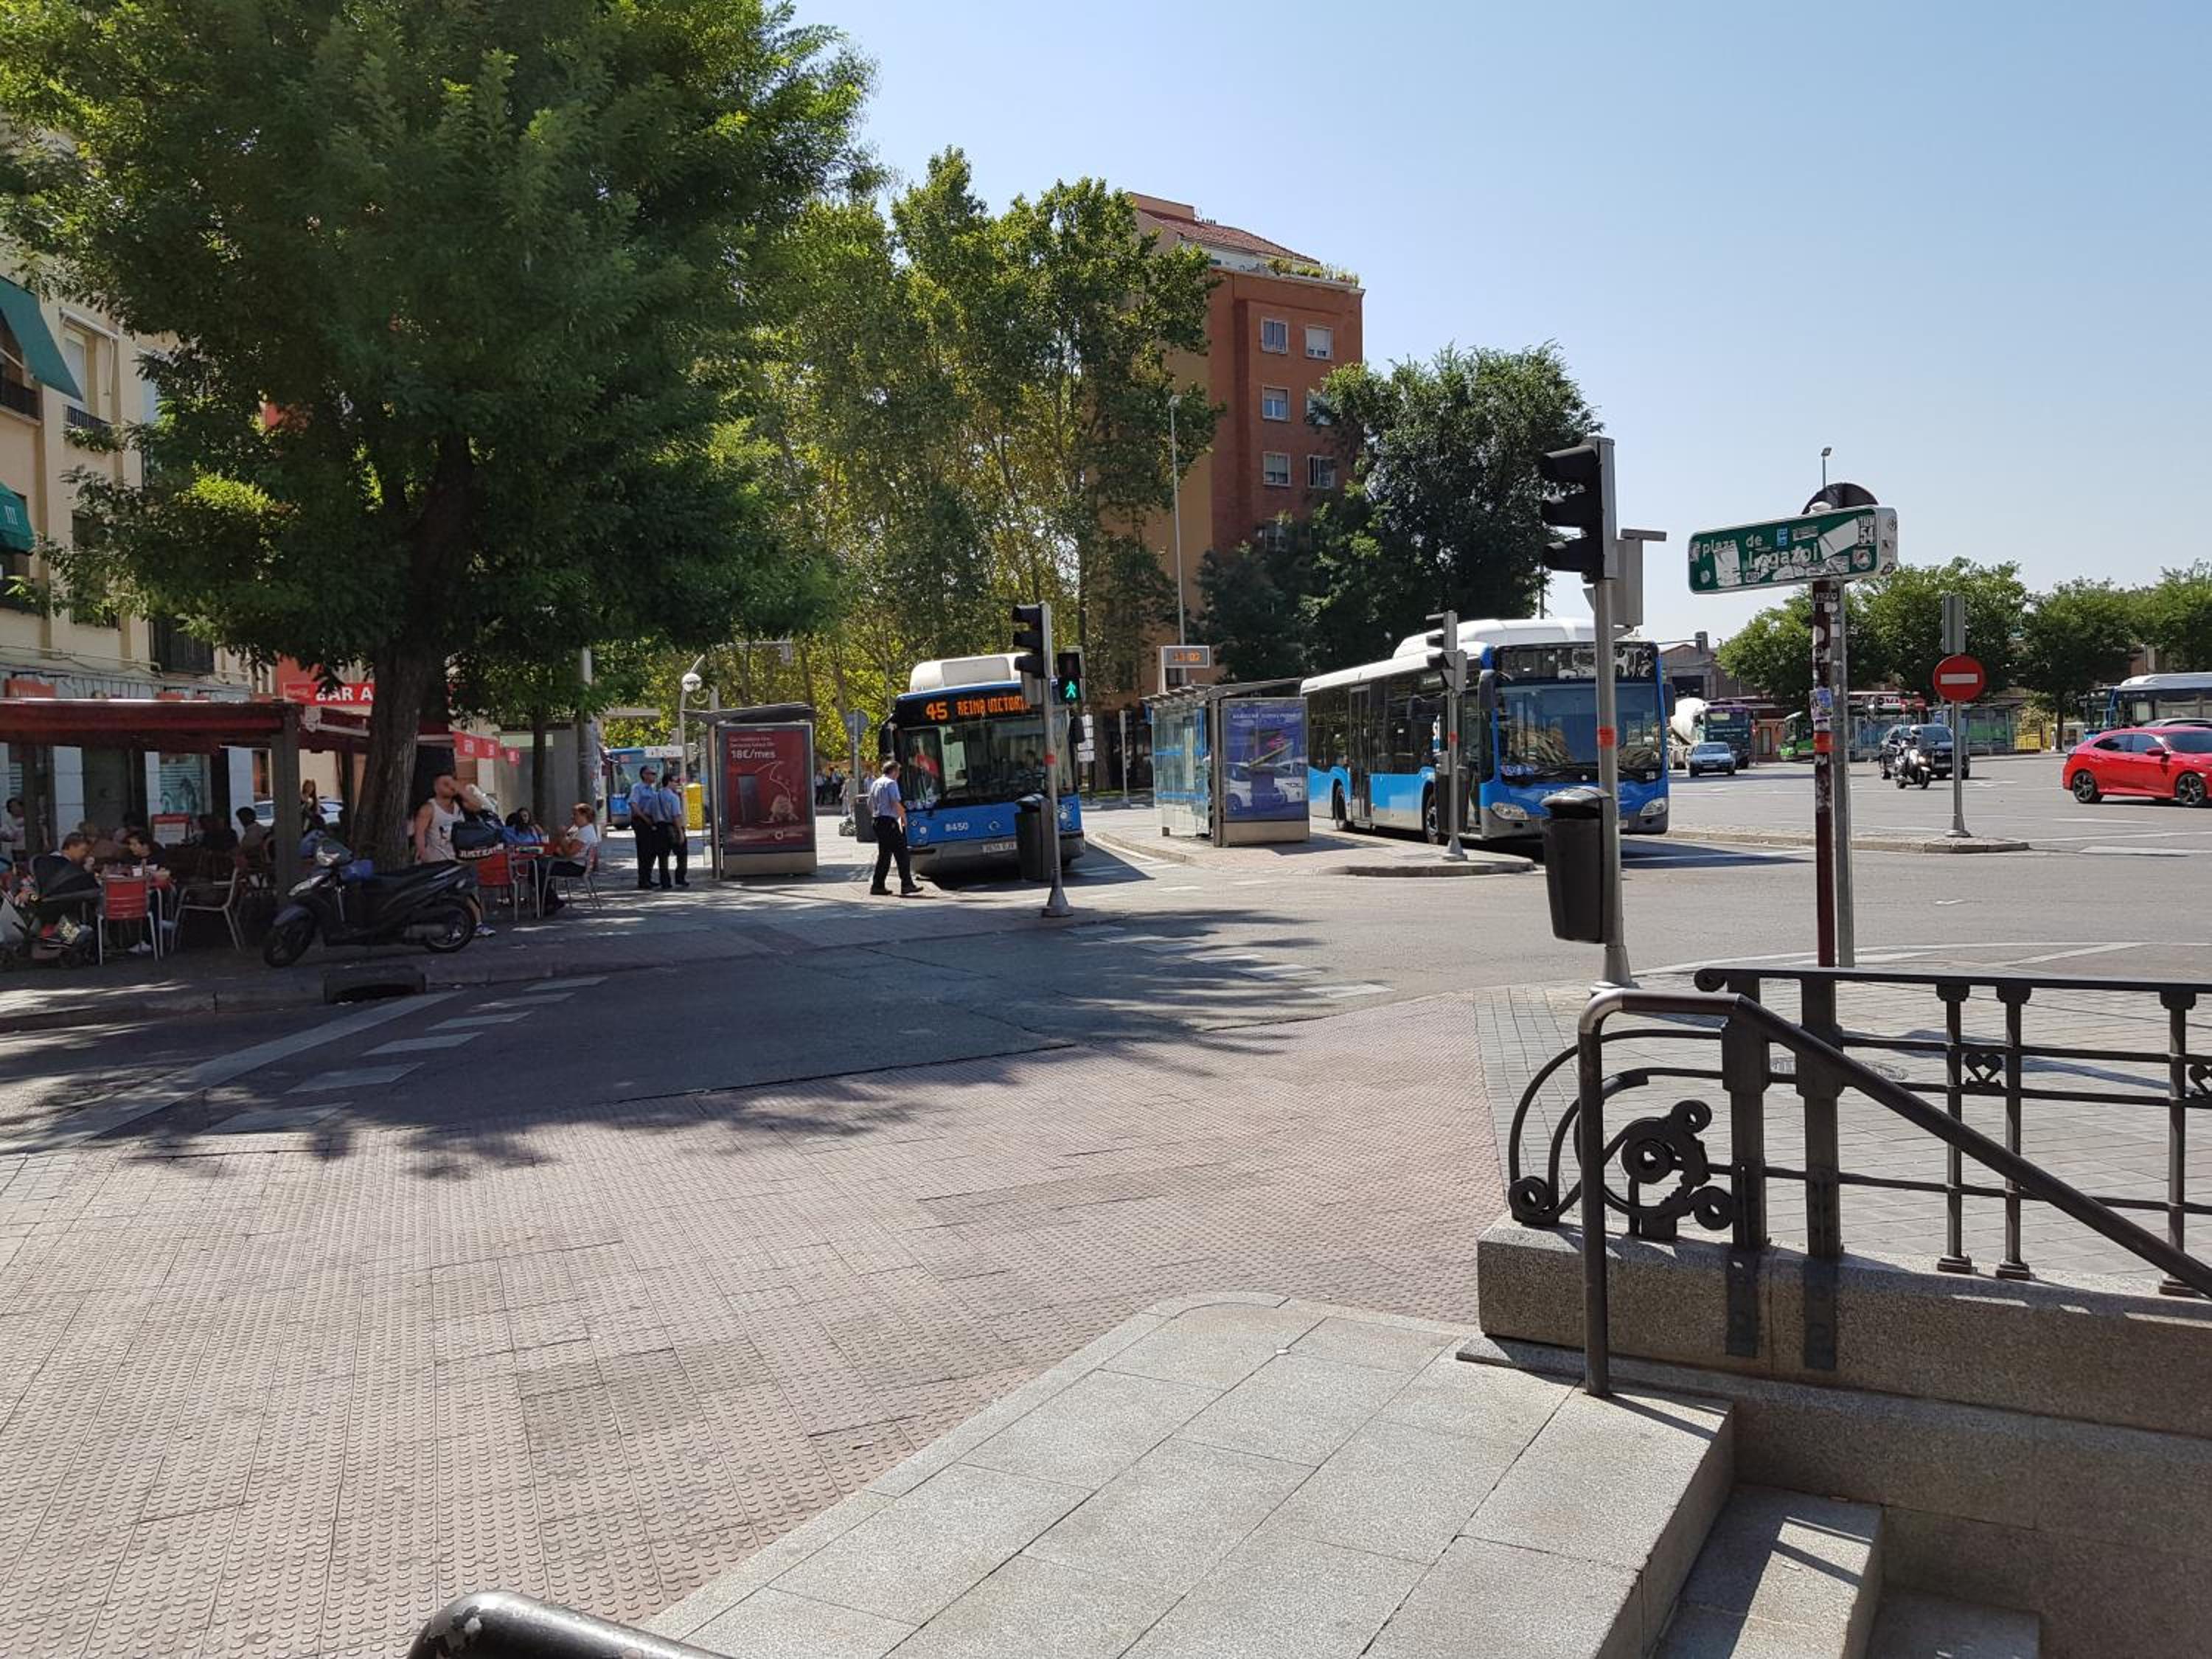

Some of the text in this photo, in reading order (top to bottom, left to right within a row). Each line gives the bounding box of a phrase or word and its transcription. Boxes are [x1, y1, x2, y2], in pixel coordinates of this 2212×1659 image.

[1860, 527, 1874, 544] 54
[1702, 539, 1736, 558] plaza
[1745, 535, 1763, 548] de
[315, 686, 354, 701] BAR
[925, 702, 949, 720] 45
[958, 700, 986, 715] REINA
[731, 748, 776, 759] 18€/mes
[945, 822, 969, 832] 8450
